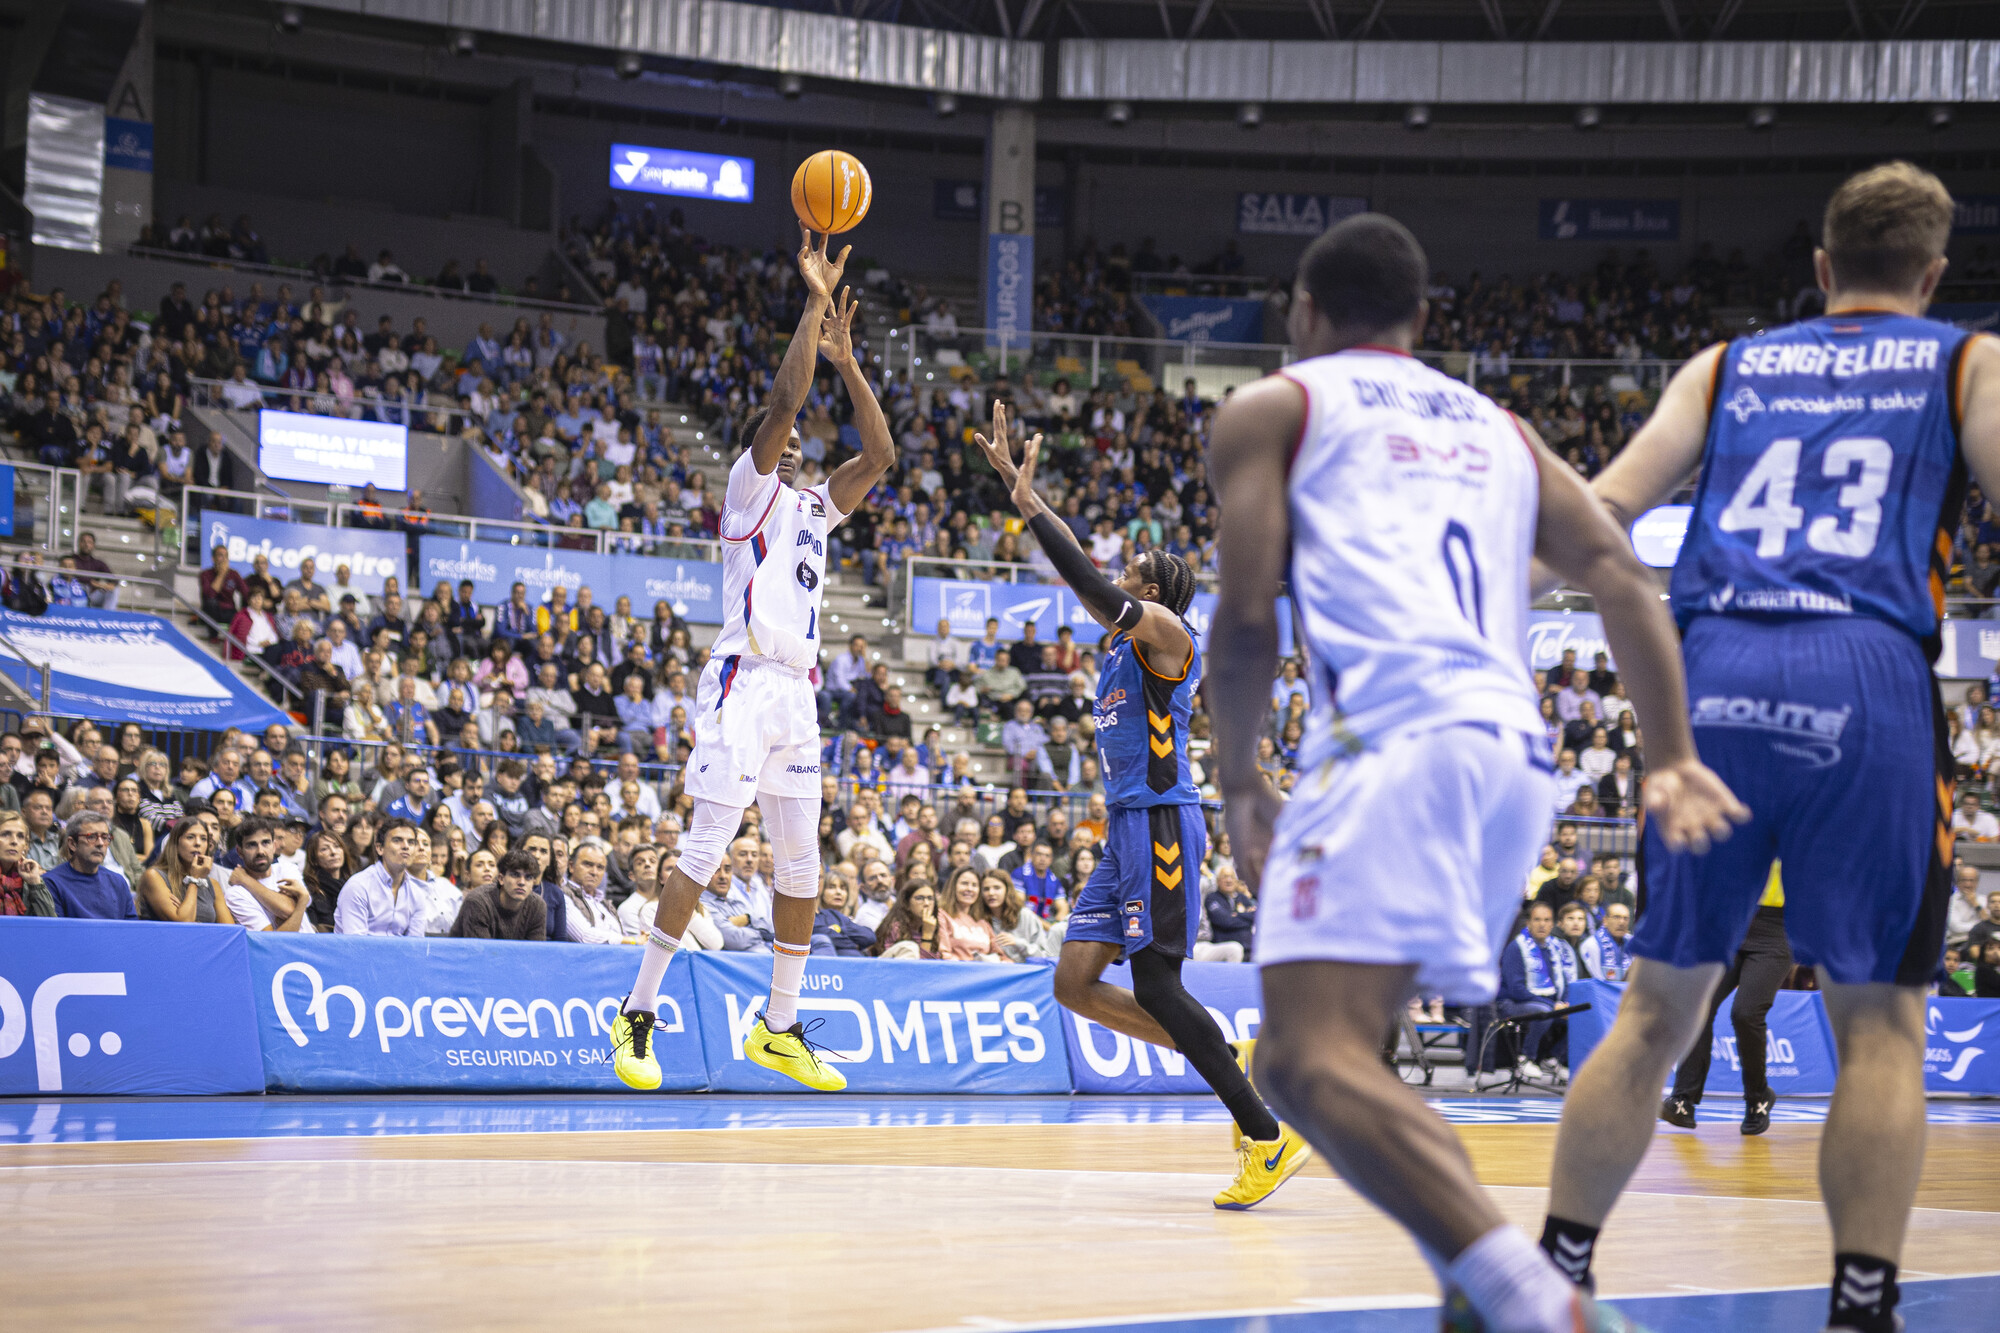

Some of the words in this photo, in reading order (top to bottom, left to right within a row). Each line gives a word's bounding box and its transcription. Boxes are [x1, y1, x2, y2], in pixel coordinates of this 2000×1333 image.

[1001, 201, 1023, 233] B
[1241, 194, 1325, 224] SALA
[1737, 338, 1940, 377] SENGFELDER
[1769, 394, 1865, 414] recoletas
[1870, 388, 1927, 411] salud
[1718, 438, 1894, 560] 43
[1442, 518, 1486, 640] 0
[806, 606, 816, 640] 1
[799, 974, 844, 991] RUPO
[375, 995, 685, 1053] prevennoa
[446, 1049, 557, 1066] SEGURIDAD
[561, 1050, 573, 1066] Y
[578, 1049, 616, 1065] SAL
